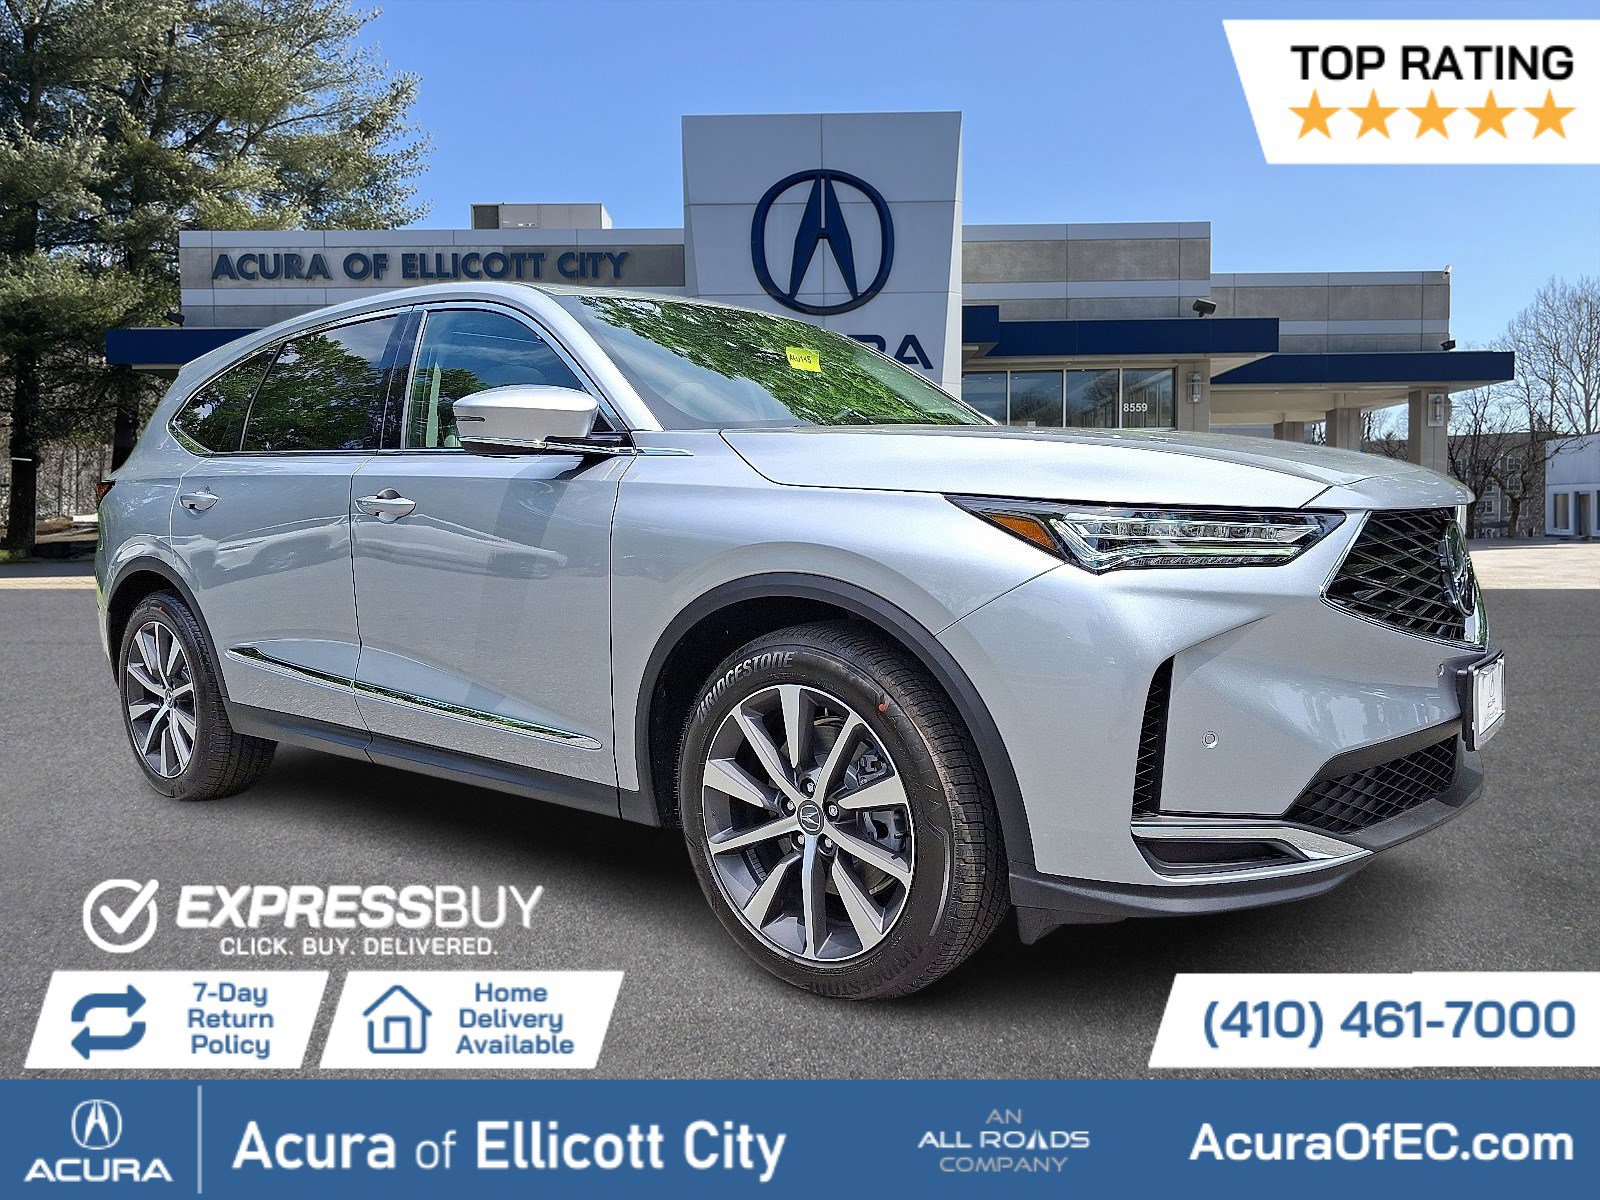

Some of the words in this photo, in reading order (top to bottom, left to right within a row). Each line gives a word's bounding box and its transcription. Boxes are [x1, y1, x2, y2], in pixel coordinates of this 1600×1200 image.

[210, 253, 333, 281] ACURA
[343, 252, 390, 281] OF
[401, 251, 546, 280] ELLICOTT
[557, 251, 630, 280] CITY
[1123, 402, 1148, 413] 8559
[696, 650, 796, 724] BRIDGESTONE
